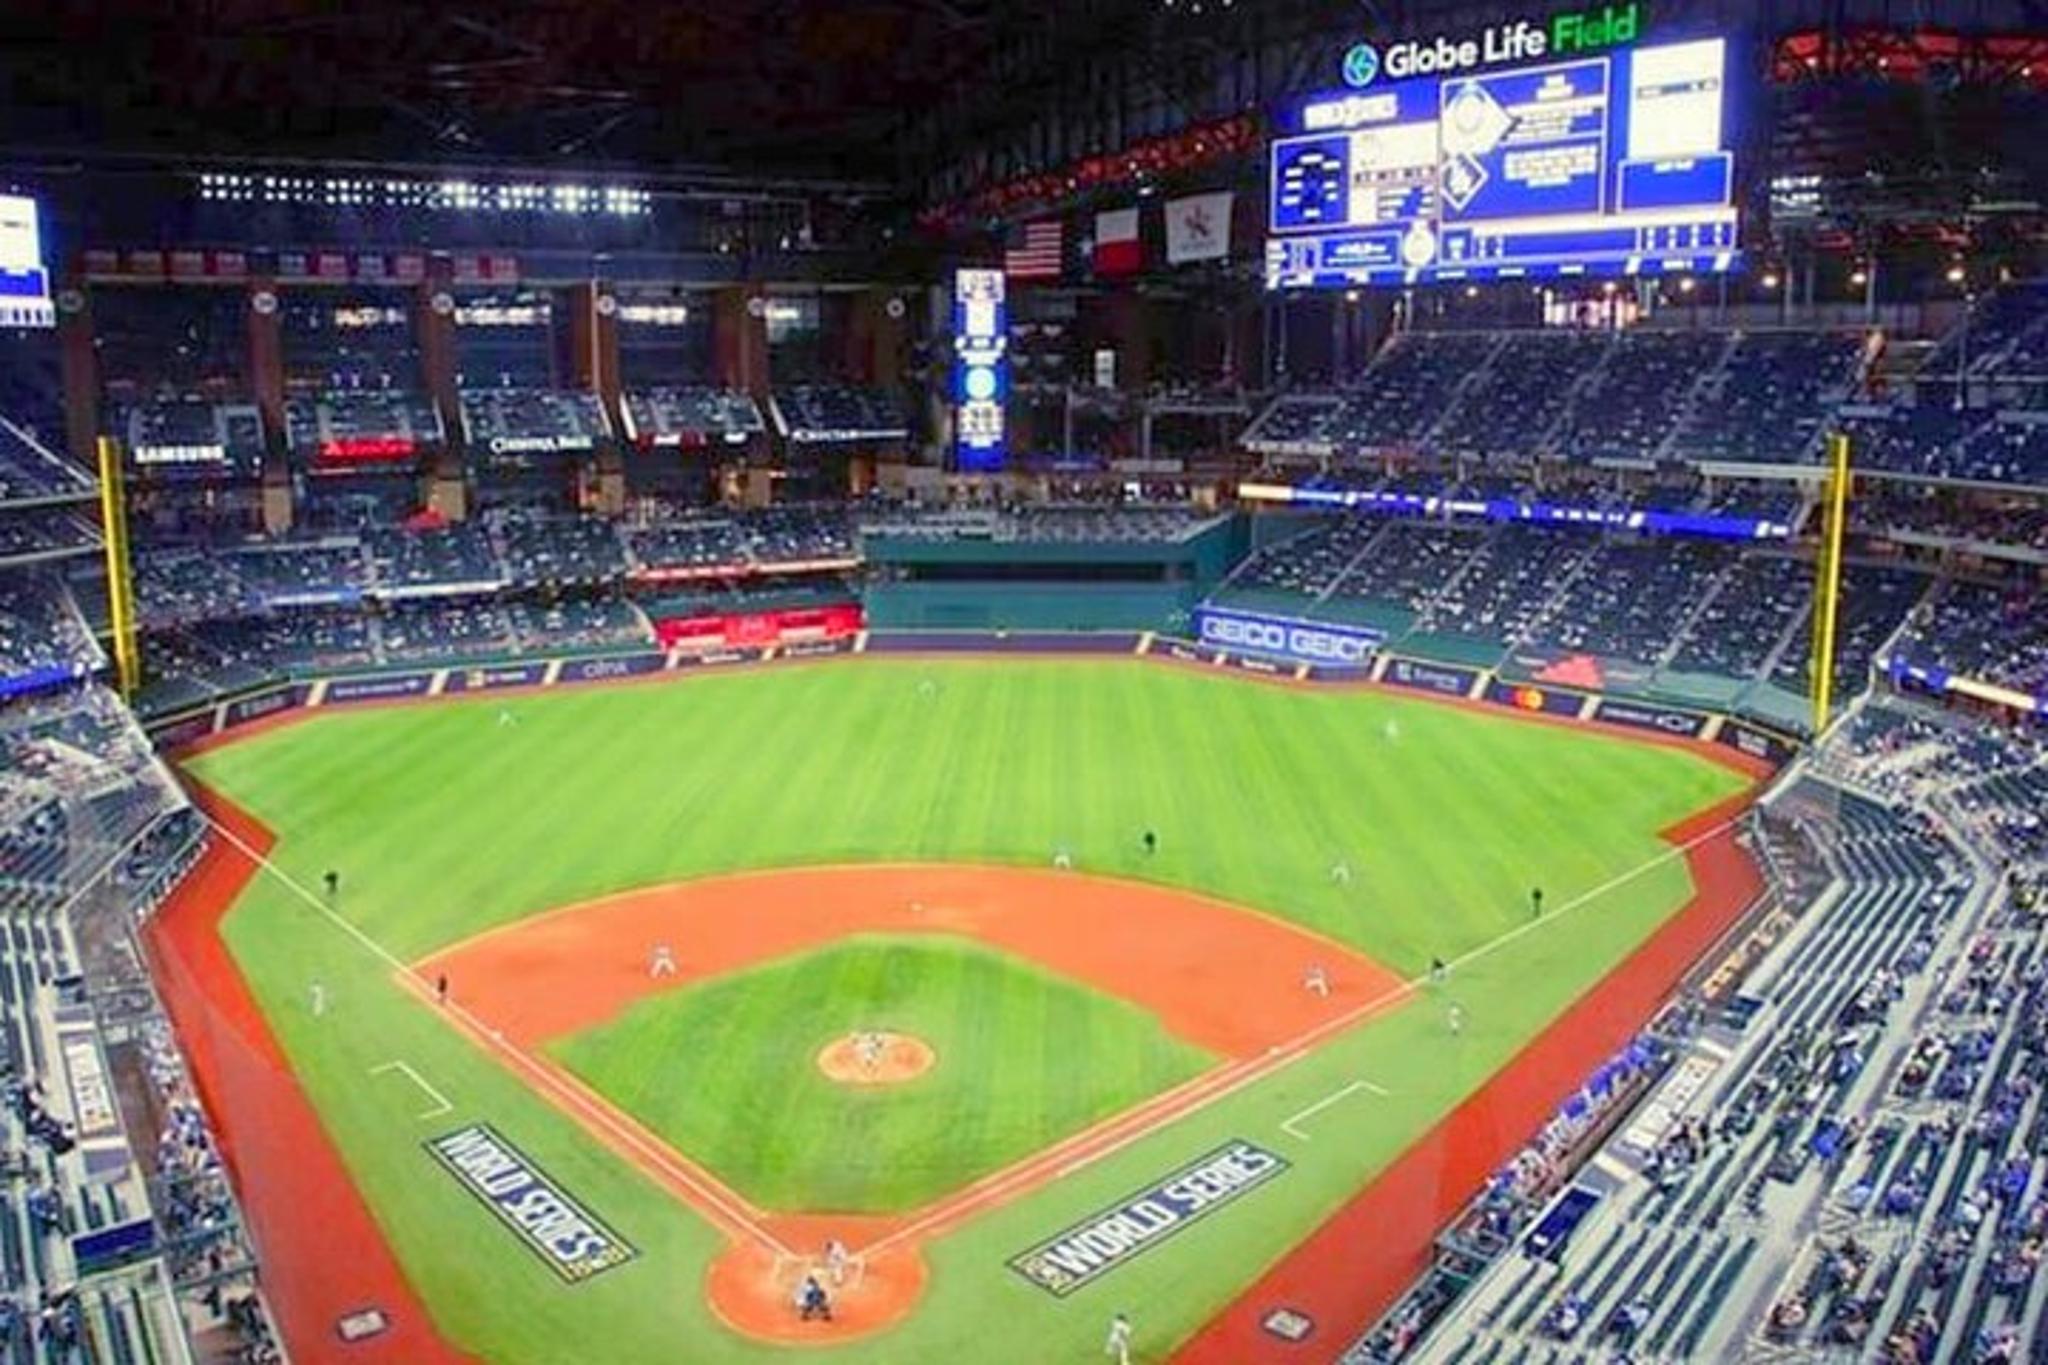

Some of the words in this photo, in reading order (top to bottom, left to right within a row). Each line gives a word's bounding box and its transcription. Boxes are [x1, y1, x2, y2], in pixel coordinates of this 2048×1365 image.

[1385, 37, 1478, 77] Globe
[1484, 22, 1546, 62] Life
[1555, 5, 1638, 50] Field
[1202, 615, 1284, 649] GEICO
[436, 1127, 536, 1196] WORLD
[500, 1188, 609, 1262] SERIES
[1043, 1200, 1180, 1274] WORLD
[1163, 1144, 1278, 1210] SERIES
